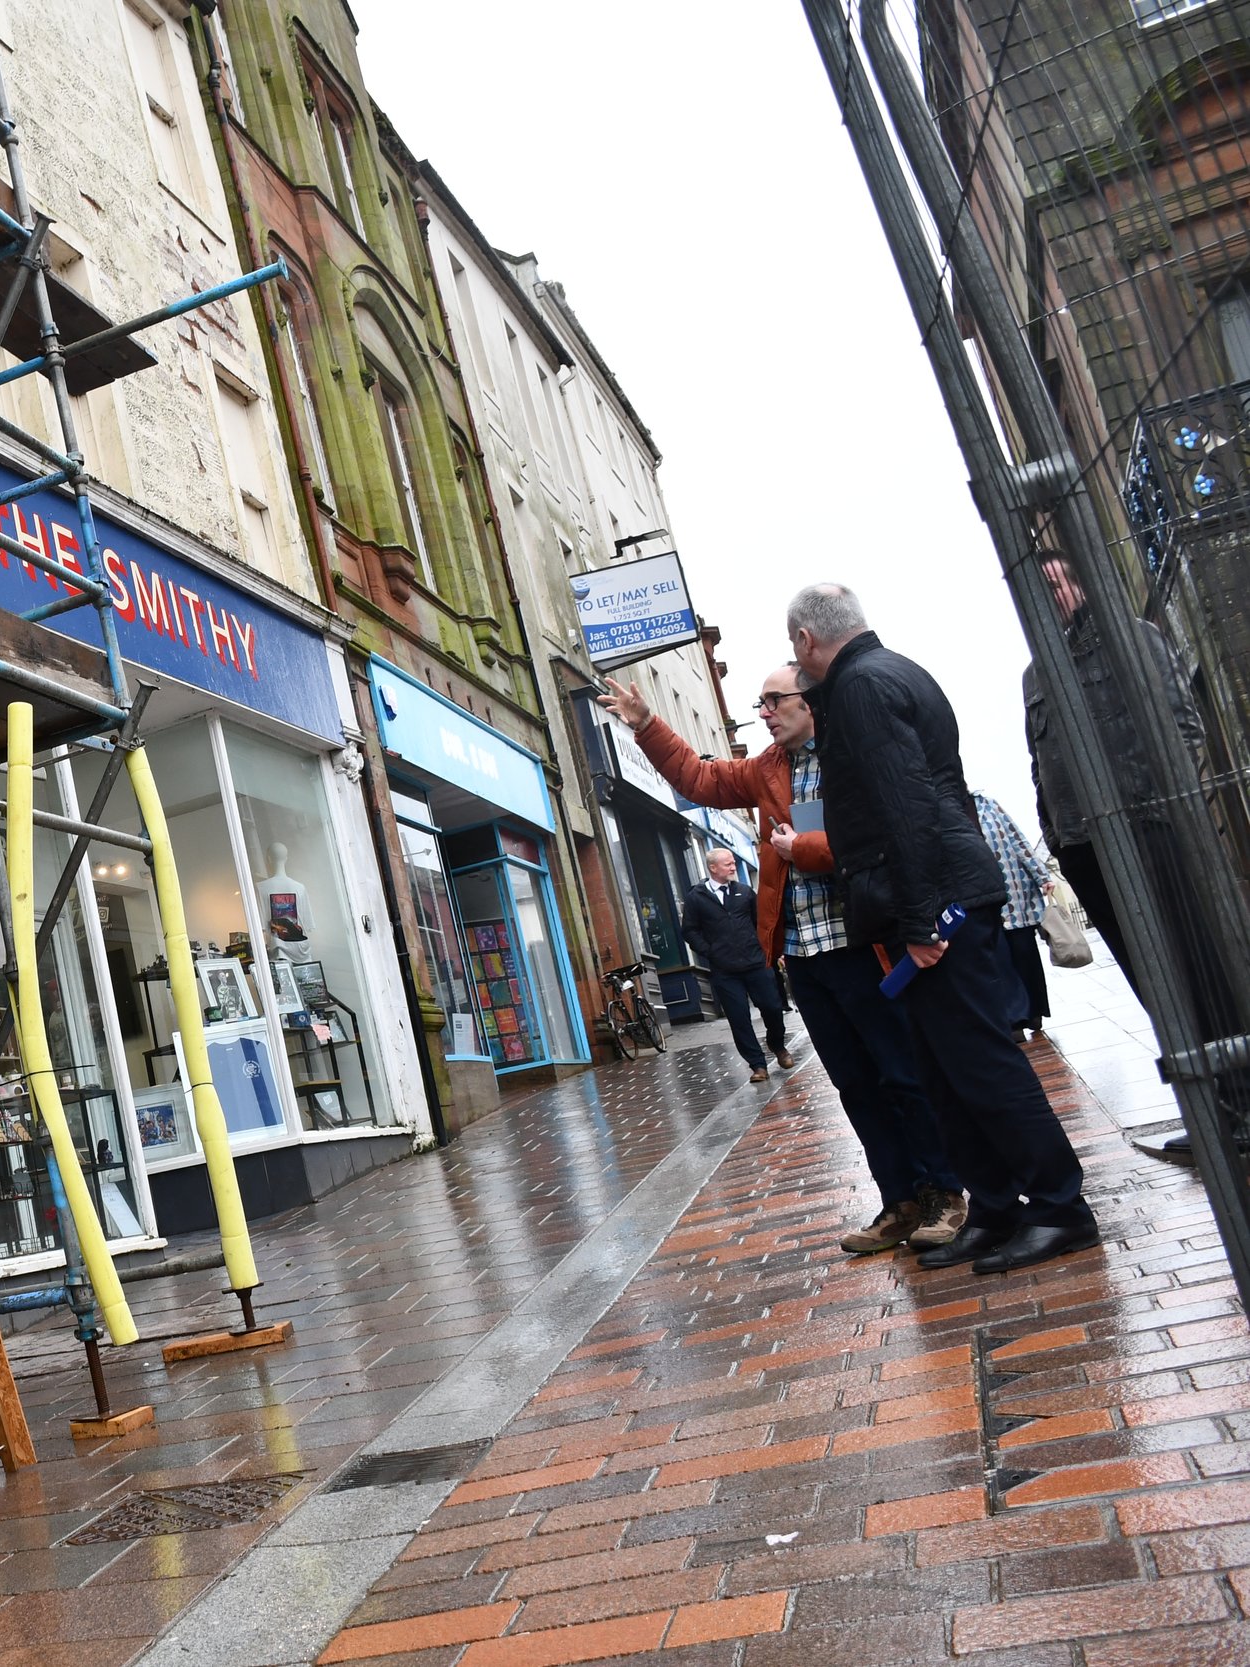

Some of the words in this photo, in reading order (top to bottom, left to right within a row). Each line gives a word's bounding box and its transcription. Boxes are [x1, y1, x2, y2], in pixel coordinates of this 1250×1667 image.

[576, 600, 594, 613] TO
[596, 586, 649, 609] LET/MAY
[652, 580, 679, 596] SELL
[607, 606, 621, 615] FULL
[622, 599, 652, 611] BUILDING
[102, 548, 259, 682] SMITHY
[589, 630, 608, 642] Jas:
[610, 621, 642, 637] 07810
[643, 612, 682, 629] 717229
[588, 639, 613, 652] Will:
[615, 631, 646, 647] 07581
[649, 621, 688, 639] 396092
